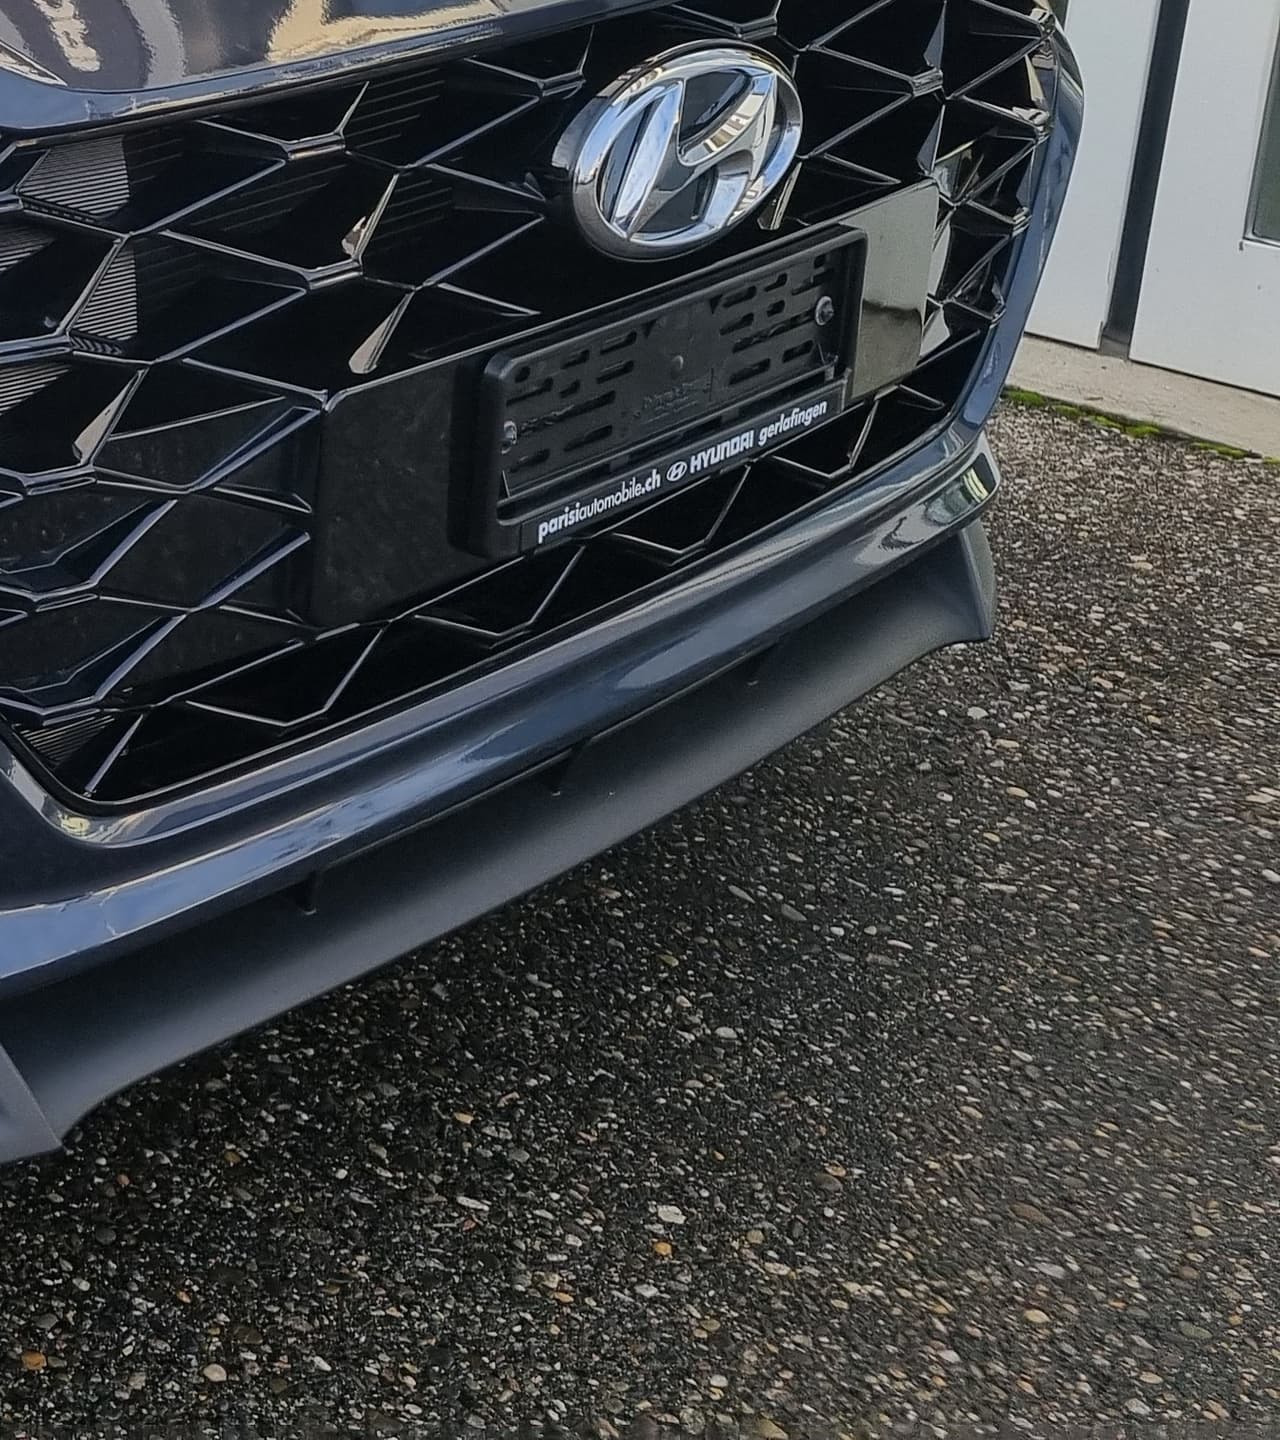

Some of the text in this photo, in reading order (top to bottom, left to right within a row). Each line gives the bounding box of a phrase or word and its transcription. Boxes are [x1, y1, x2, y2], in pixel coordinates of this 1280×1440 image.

[537, 400, 828, 544] parisiautomobile.ch HYUNDAI gerlafingen
